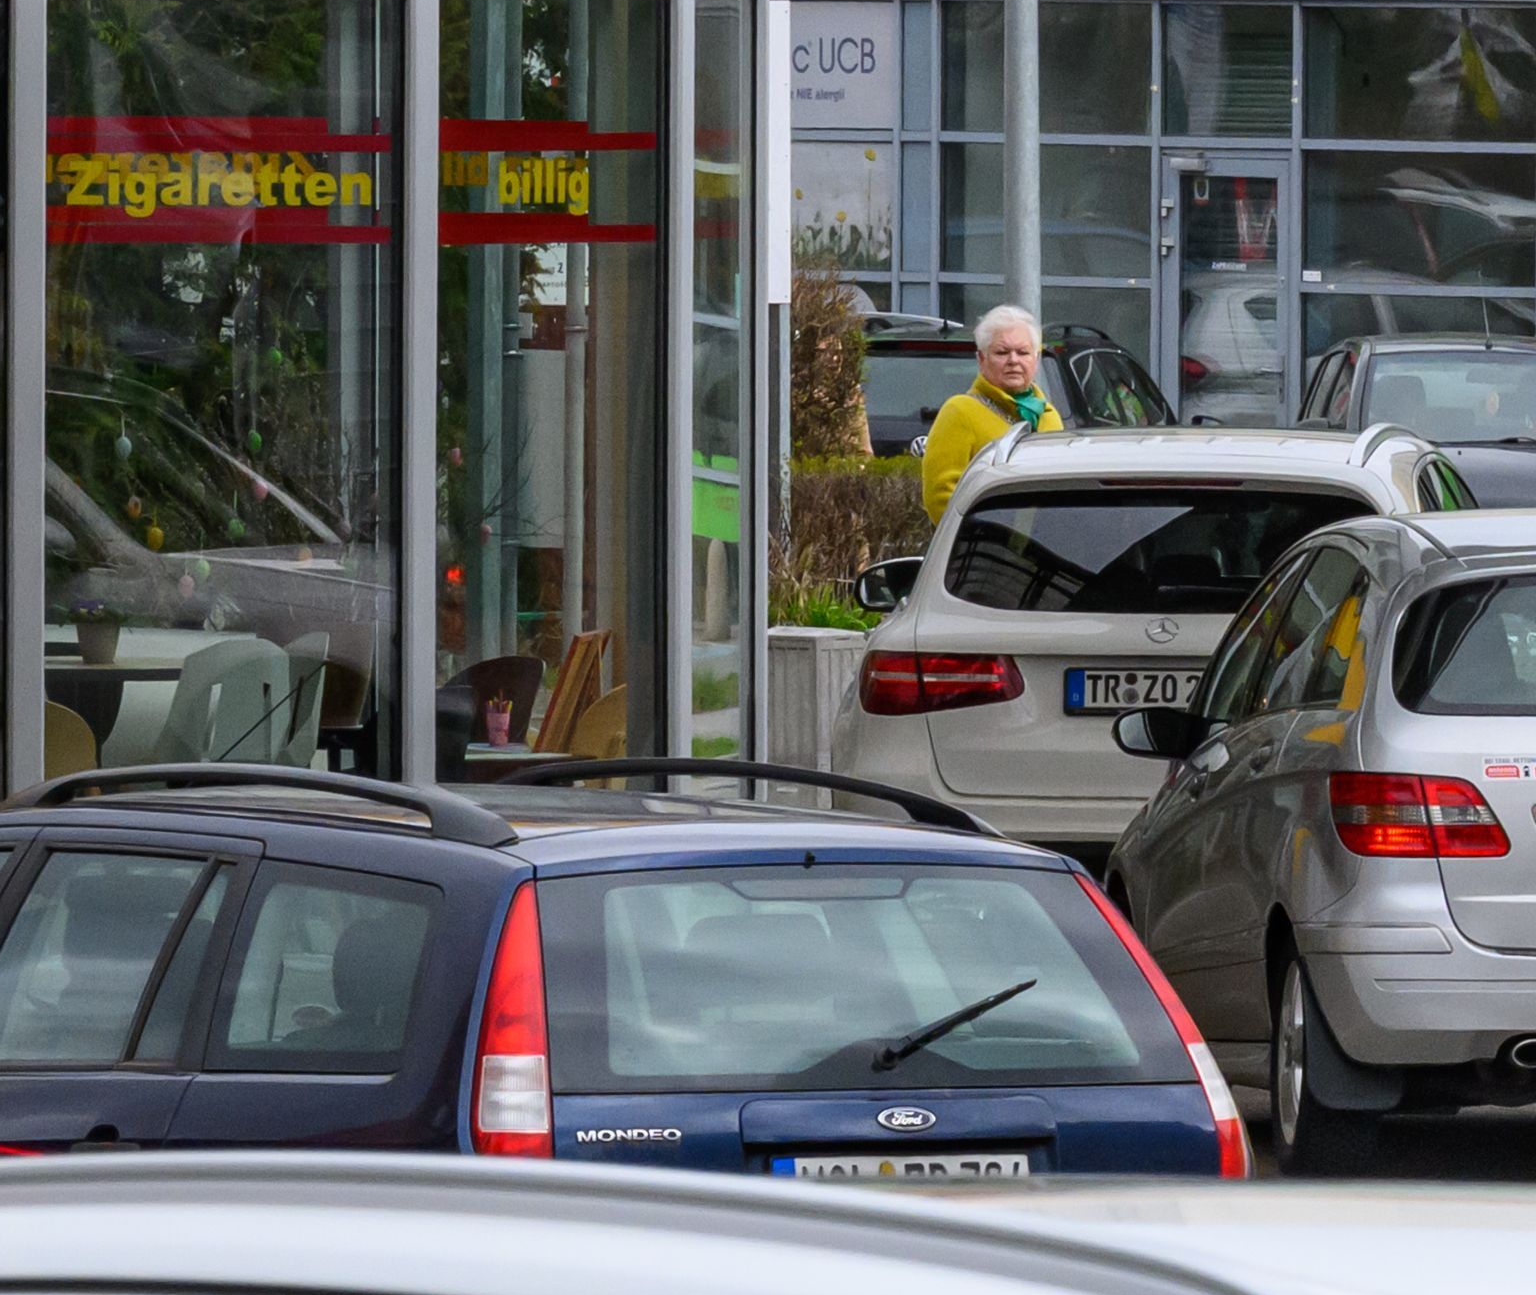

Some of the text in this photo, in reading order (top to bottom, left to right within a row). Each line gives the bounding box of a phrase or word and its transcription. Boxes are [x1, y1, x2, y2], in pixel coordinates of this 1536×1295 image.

[819, 37, 875, 73] UCB
[67, 159, 372, 217] Zigaretten
[498, 158, 589, 216] billig
[1086, 674, 1120, 703] TR
[1143, 674, 1178, 703] ZO
[891, 1111, 923, 1126] Ford
[576, 1128, 682, 1143] MONDEO
